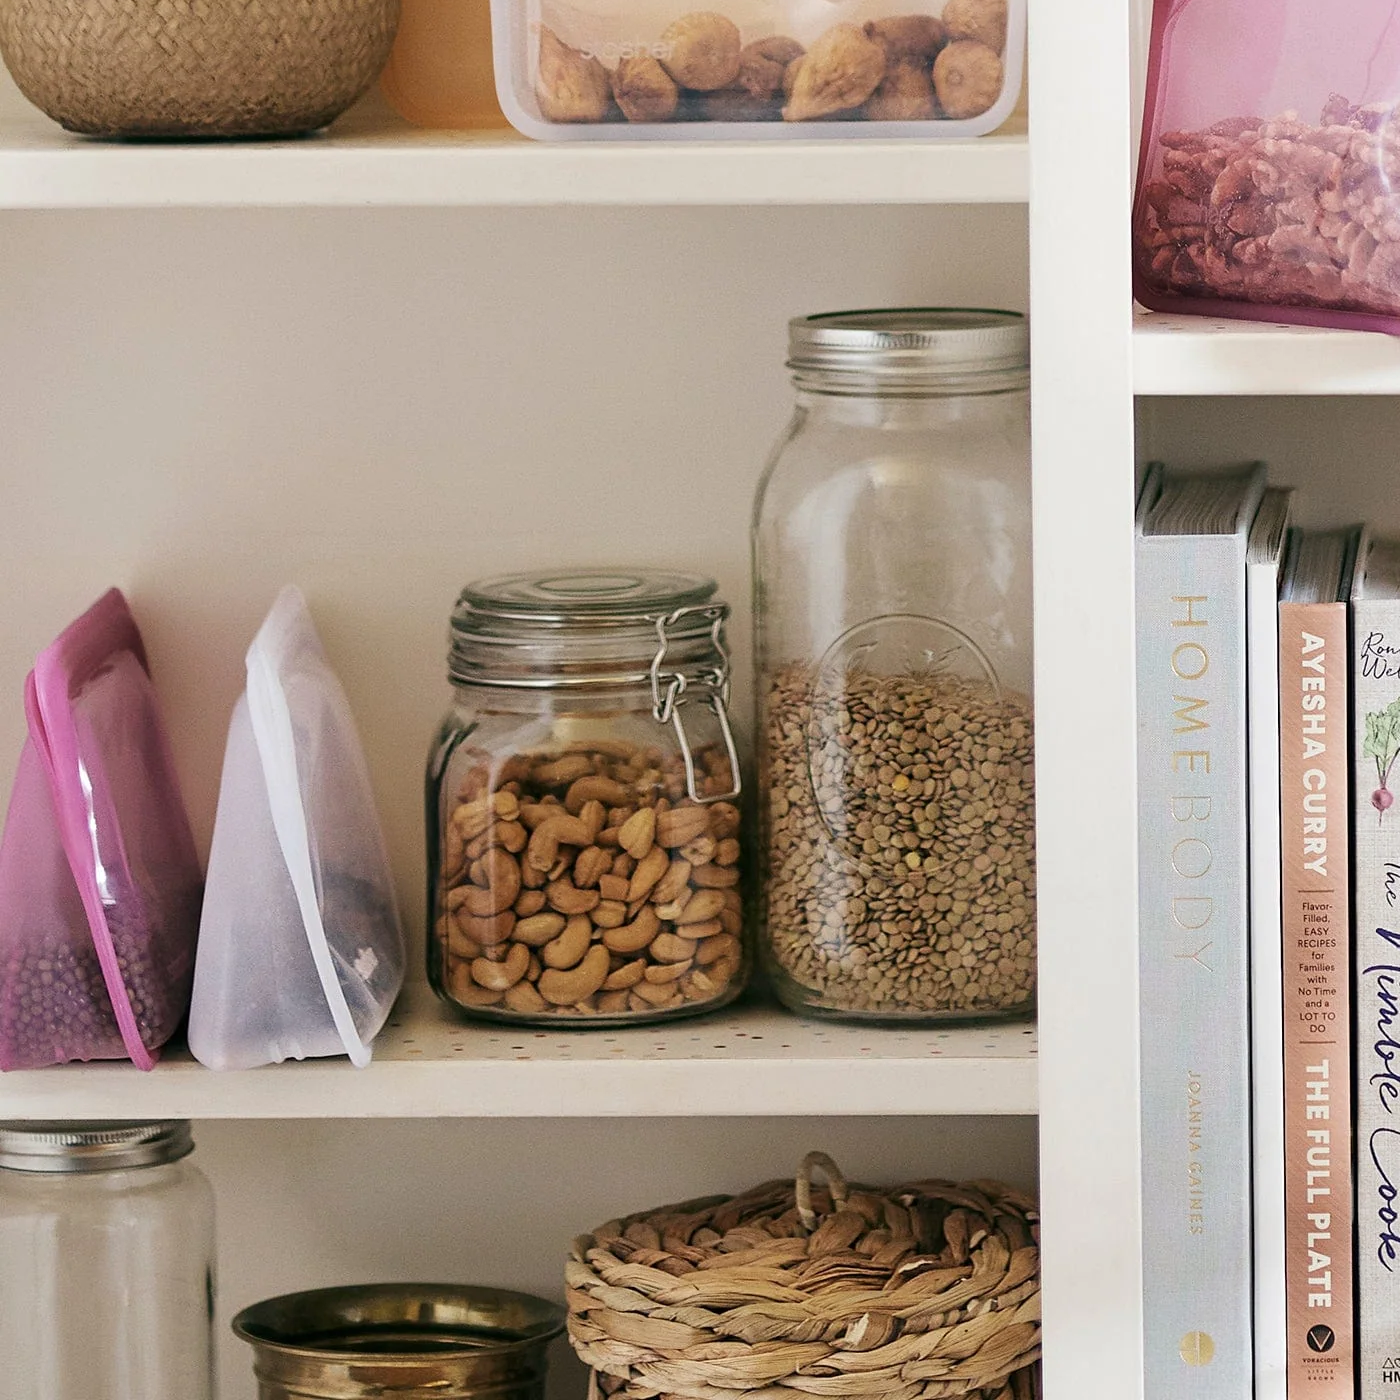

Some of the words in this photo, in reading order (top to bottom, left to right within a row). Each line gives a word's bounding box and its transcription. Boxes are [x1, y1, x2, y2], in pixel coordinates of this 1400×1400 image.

[1301, 631, 1327, 760] AYESHA
[1170, 595, 1214, 973] HOMEBODY
[1302, 768, 1328, 877] CURRY
[1302, 902, 1333, 911] Flavor-
[1304, 927, 1330, 936] EASY
[1297, 939, 1337, 948] RECIPES
[1311, 951, 1325, 960] for
[1299, 963, 1336, 972] Families
[1306, 975, 1328, 984] with
[1298, 987, 1312, 996] No
[1314, 986, 1337, 996] Time
[1305, 999, 1322, 1008] and
[1299, 1012, 1319, 1021] LOT
[1321, 1012, 1336, 1021] TO
[1309, 1024, 1326, 1033] DO
[1305, 1059, 1330, 1120] THE
[1186, 1069, 1202, 1153] JOANNA
[1306, 1129, 1331, 1204] FULL
[1187, 1161, 1203, 1236] GAINES
[1307, 1212, 1332, 1308] PLATE
